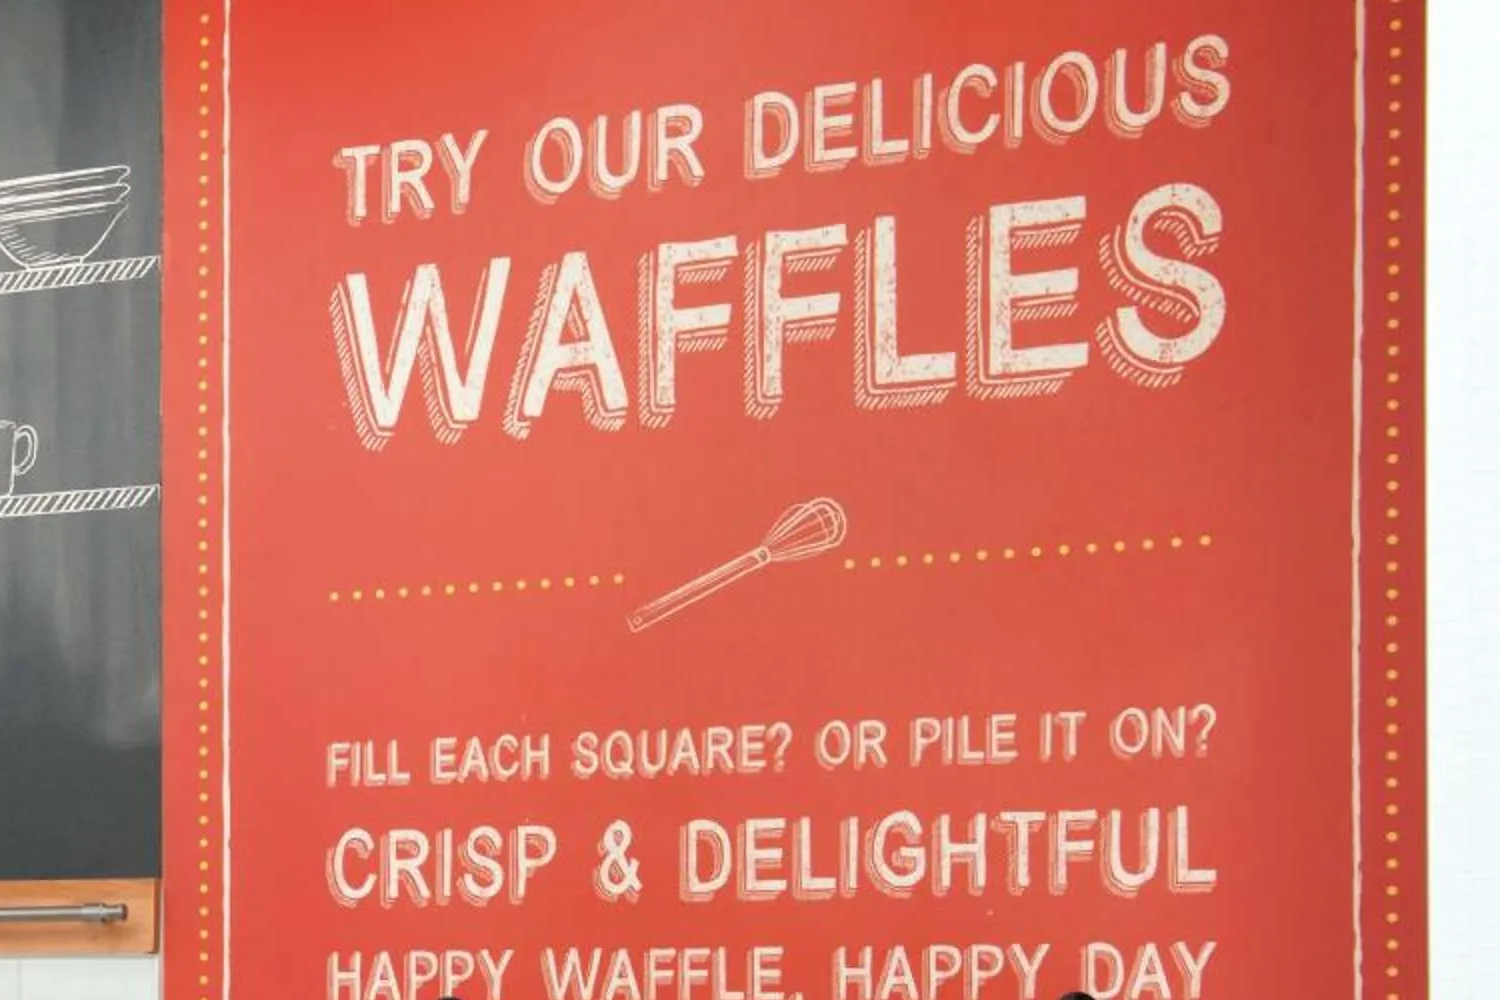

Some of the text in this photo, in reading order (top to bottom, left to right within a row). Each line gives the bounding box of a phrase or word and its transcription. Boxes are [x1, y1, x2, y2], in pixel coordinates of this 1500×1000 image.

[333, 34, 1230, 226] TRY OUR DELICIOUS
[329, 182, 1225, 452] WAFFLES
[327, 704, 1216, 787] FILL EACH SQUARE? OR PILE IT ON?
[326, 805, 1217, 909] CRISP & DELIGHTFUL
